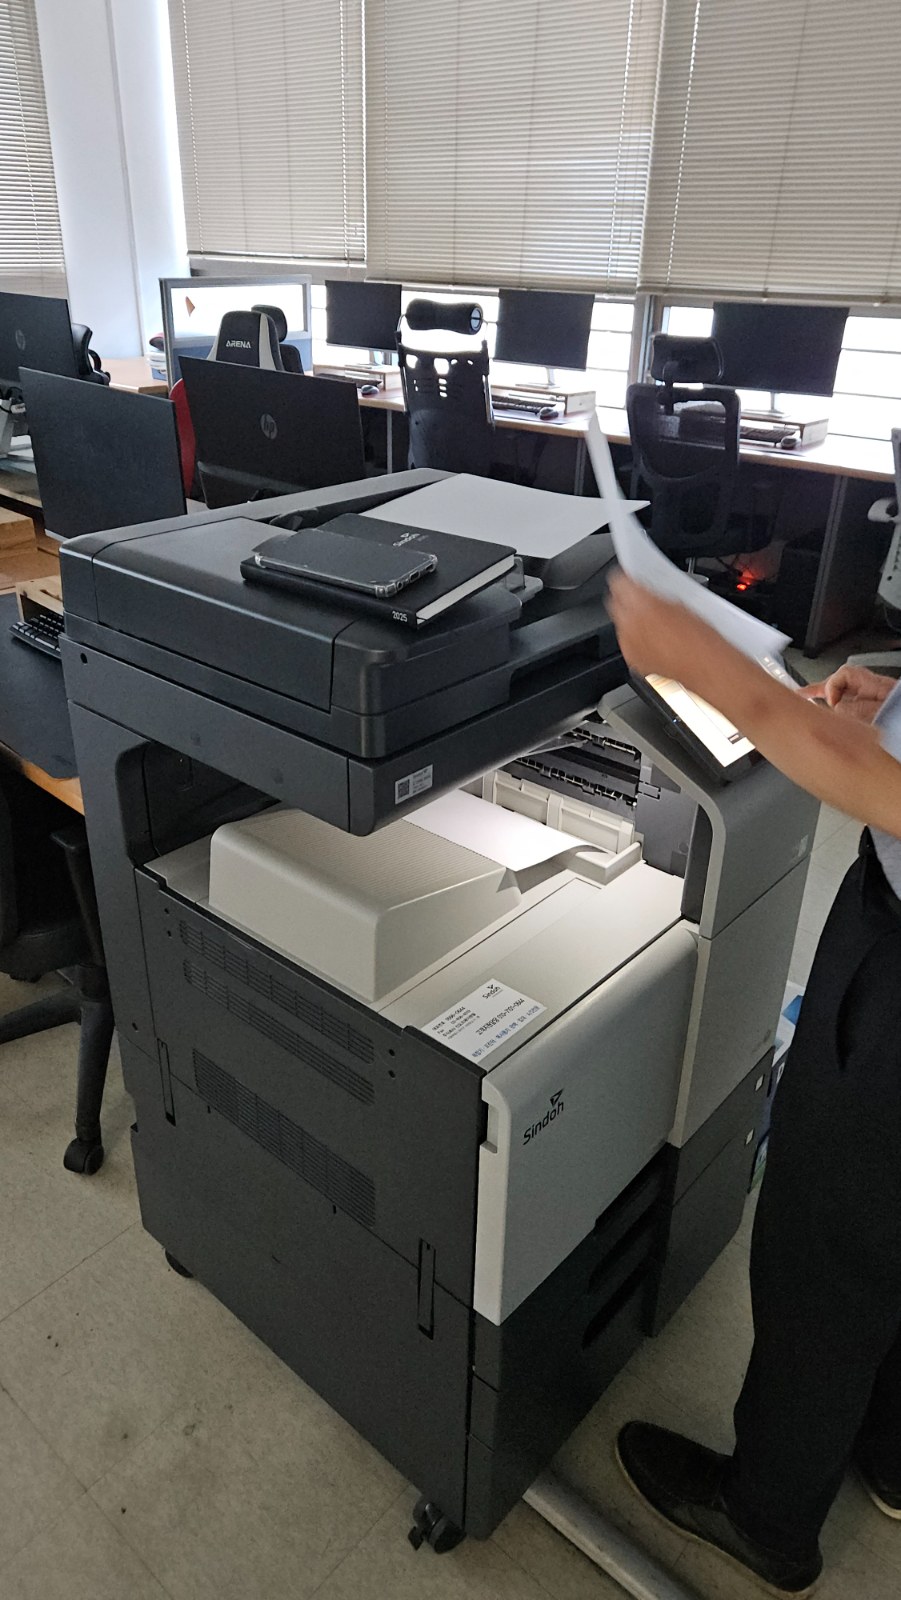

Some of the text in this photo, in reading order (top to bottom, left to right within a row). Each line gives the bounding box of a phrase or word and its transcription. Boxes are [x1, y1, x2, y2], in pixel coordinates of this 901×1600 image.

[225, 340, 252, 349] ARENA
[260, 414, 278, 439] hp
[392, 610, 408, 622] 2025
[482, 987, 501, 999] Sindoh
[523, 1101, 564, 1146] Sindoh
